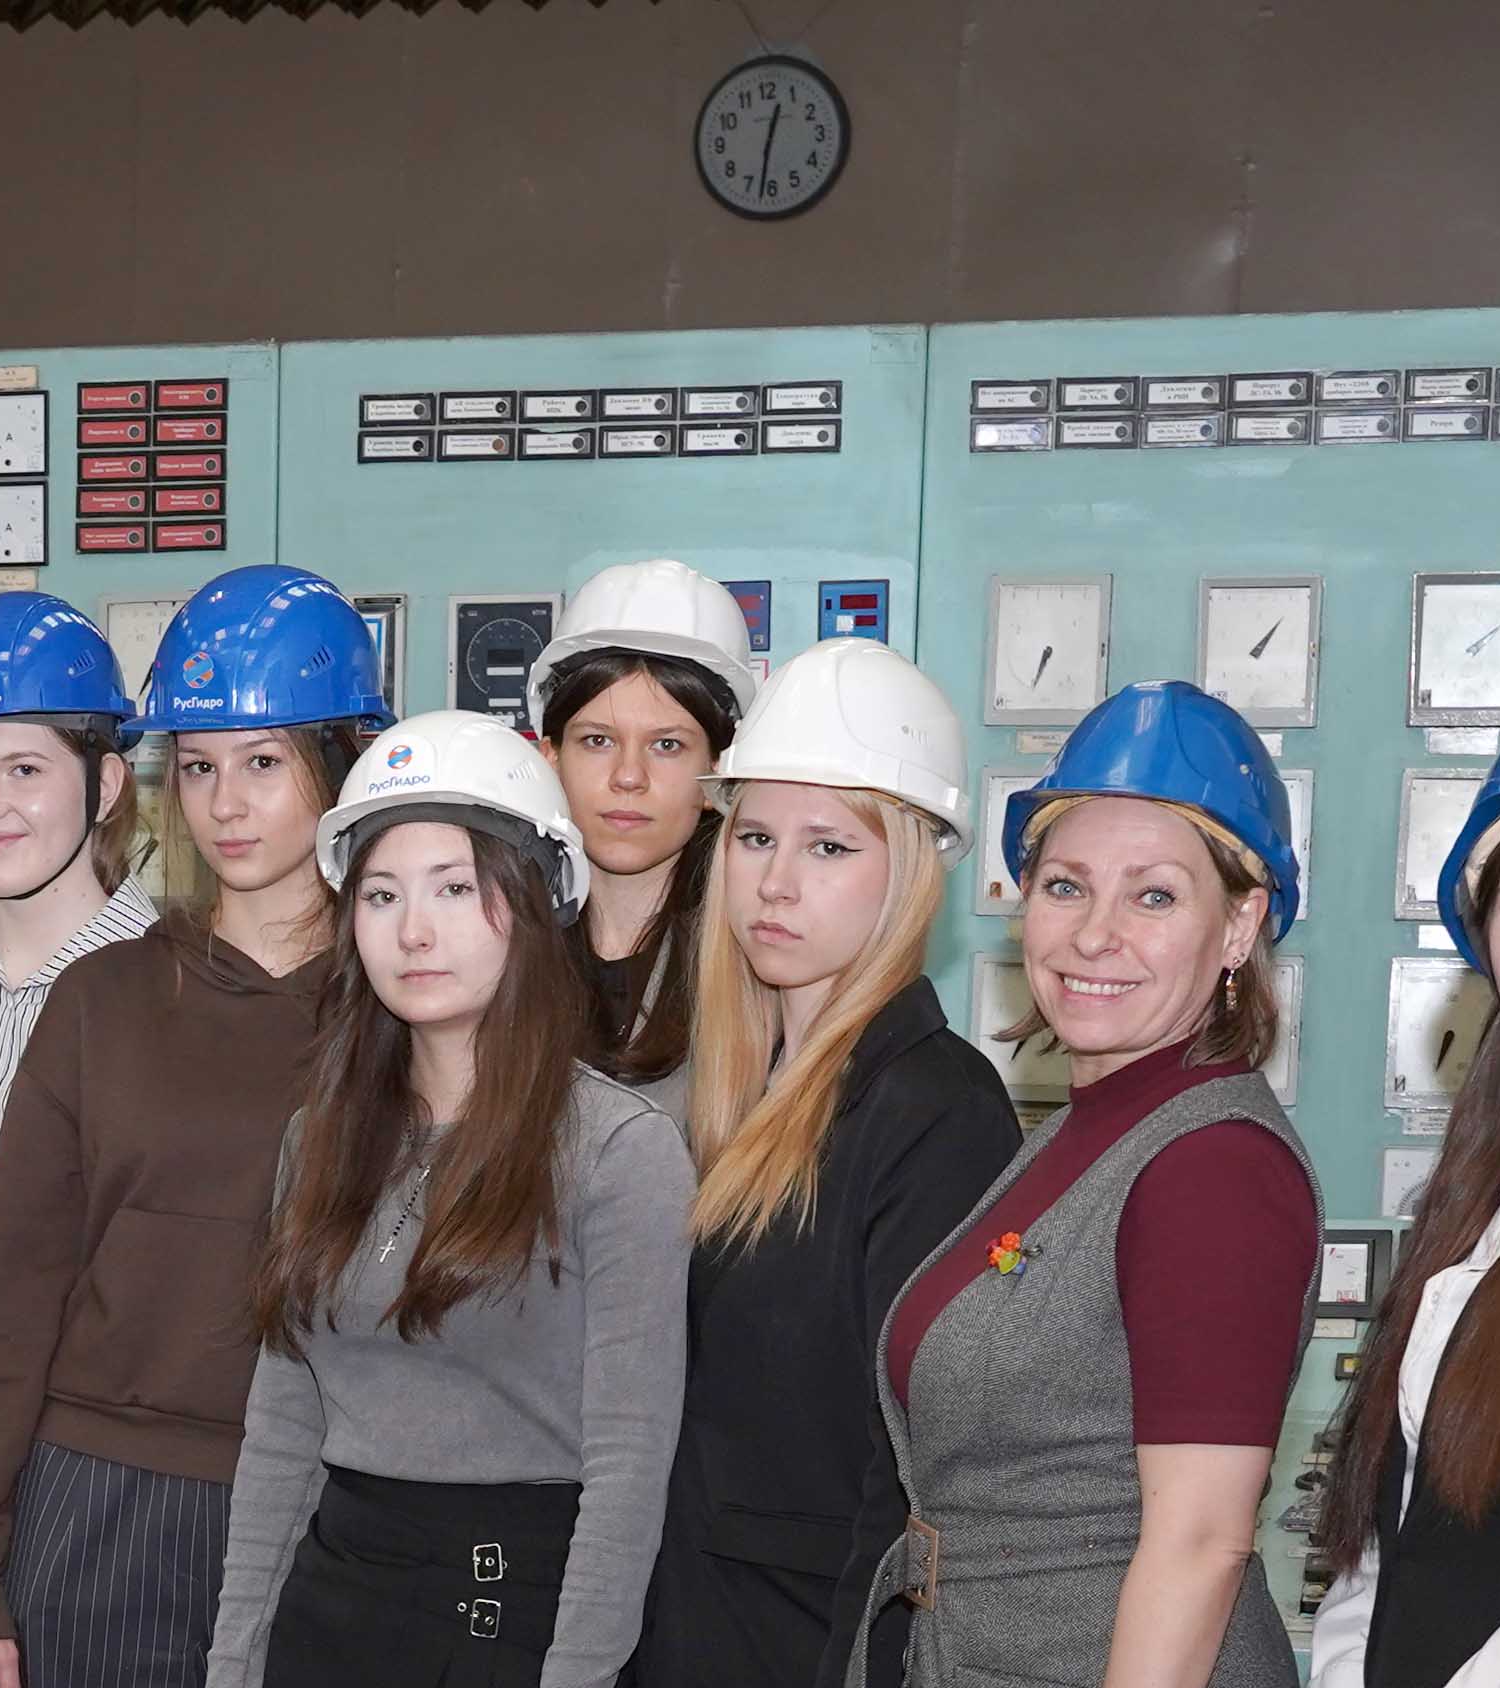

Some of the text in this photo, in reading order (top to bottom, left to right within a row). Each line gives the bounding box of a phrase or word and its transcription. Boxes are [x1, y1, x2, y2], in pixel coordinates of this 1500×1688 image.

[759, 82, 776, 99] 12
[789, 86, 796, 102] 1
[739, 91, 752, 108] 11
[805, 104, 816, 121] 2
[720, 113, 737, 130] 10
[815, 125, 825, 142] 3
[715, 138, 725, 154] 9
[806, 152, 818, 168] 4
[725, 161, 736, 177] 8
[744, 176, 754, 193] 7
[789, 171, 800, 188] 5
[766, 181, 777, 197] 6
[173, 696, 224, 711] РусГидро
[368, 775, 431, 797] РусГидро
